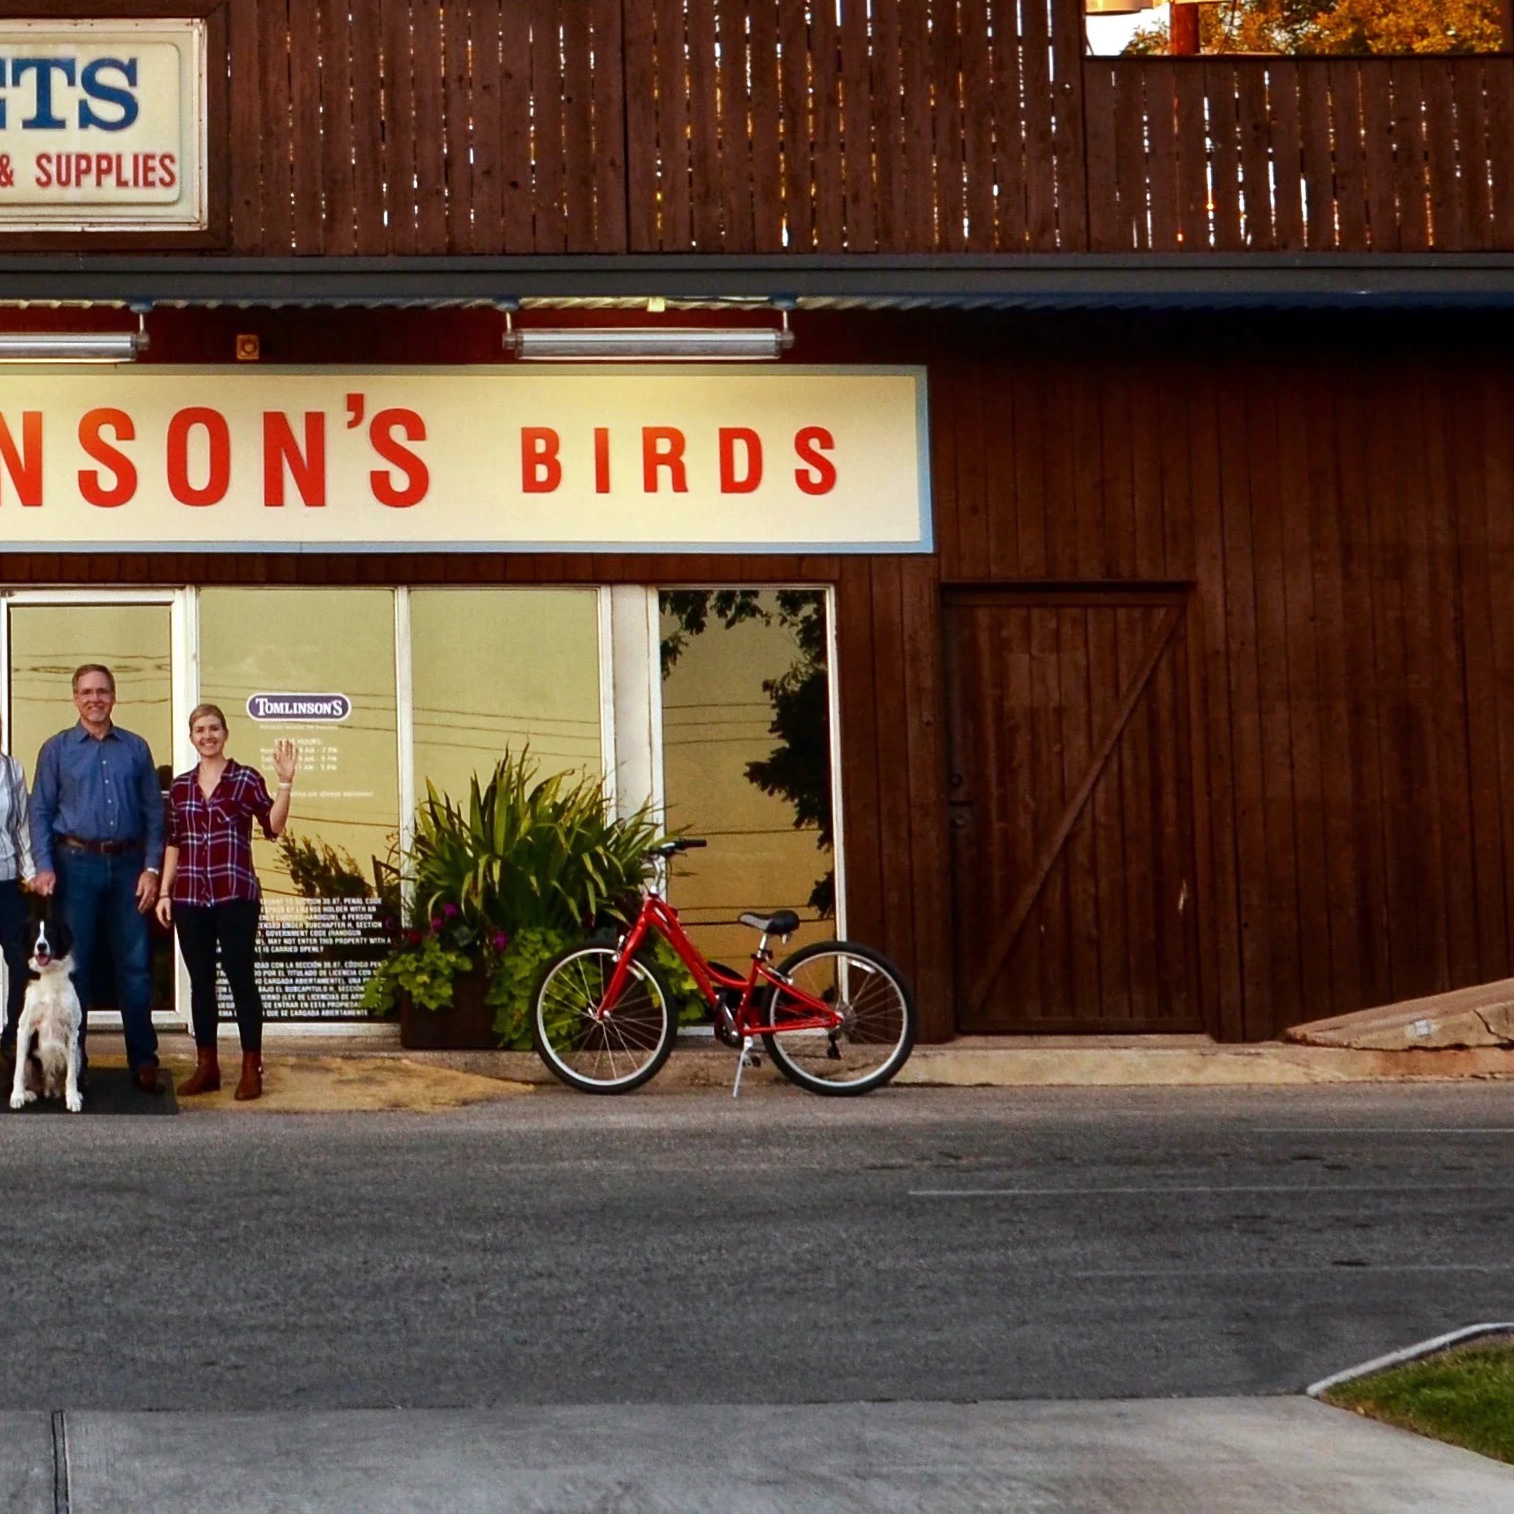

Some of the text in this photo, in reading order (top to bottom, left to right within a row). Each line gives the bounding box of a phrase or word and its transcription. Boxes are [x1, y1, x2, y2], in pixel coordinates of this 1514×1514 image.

[36, 154, 176, 188] SUPPLIES
[520, 425, 838, 496] BIRDS
[327, 1001, 362, 1009] PROPIEDA
